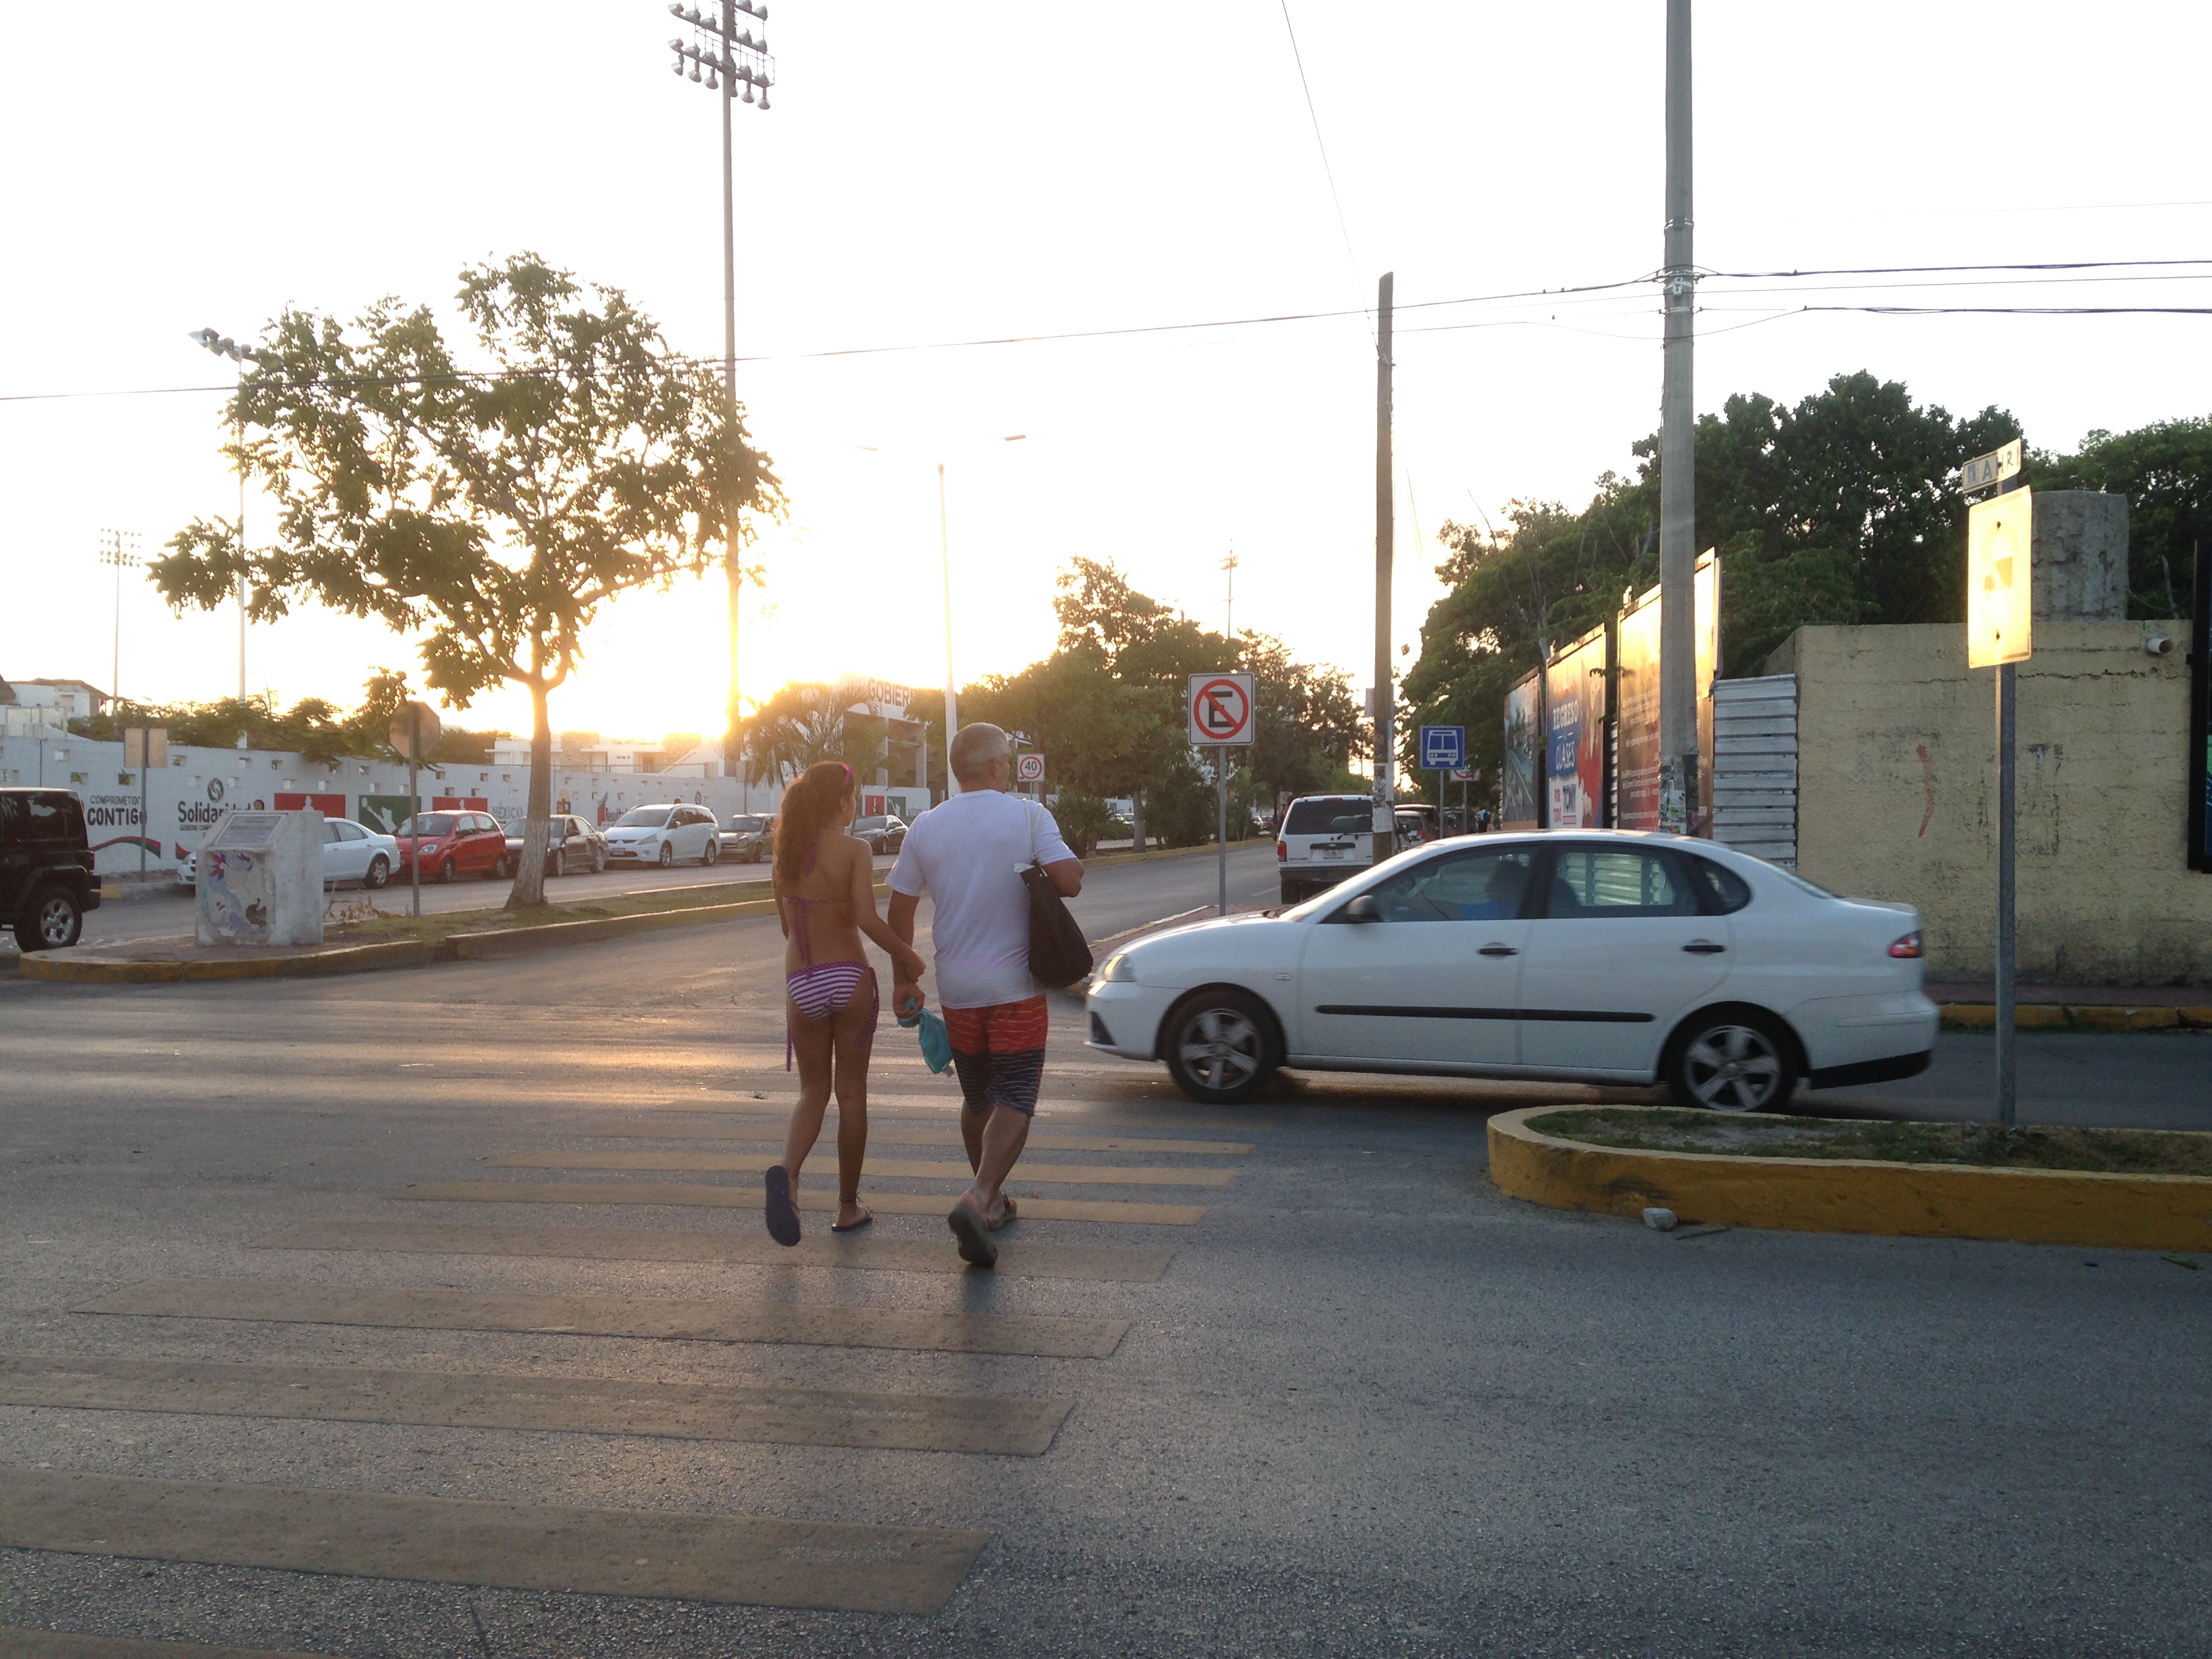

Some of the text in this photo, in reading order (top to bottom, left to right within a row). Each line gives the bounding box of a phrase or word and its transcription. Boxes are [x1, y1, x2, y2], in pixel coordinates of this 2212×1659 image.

[868, 678, 914, 707] GOBIERN
[1553, 699, 1578, 730] REGRESO
[1025, 761, 1037, 771] 40
[1556, 741, 1575, 770] CLASES
[178, 800, 251, 823] Solidar
